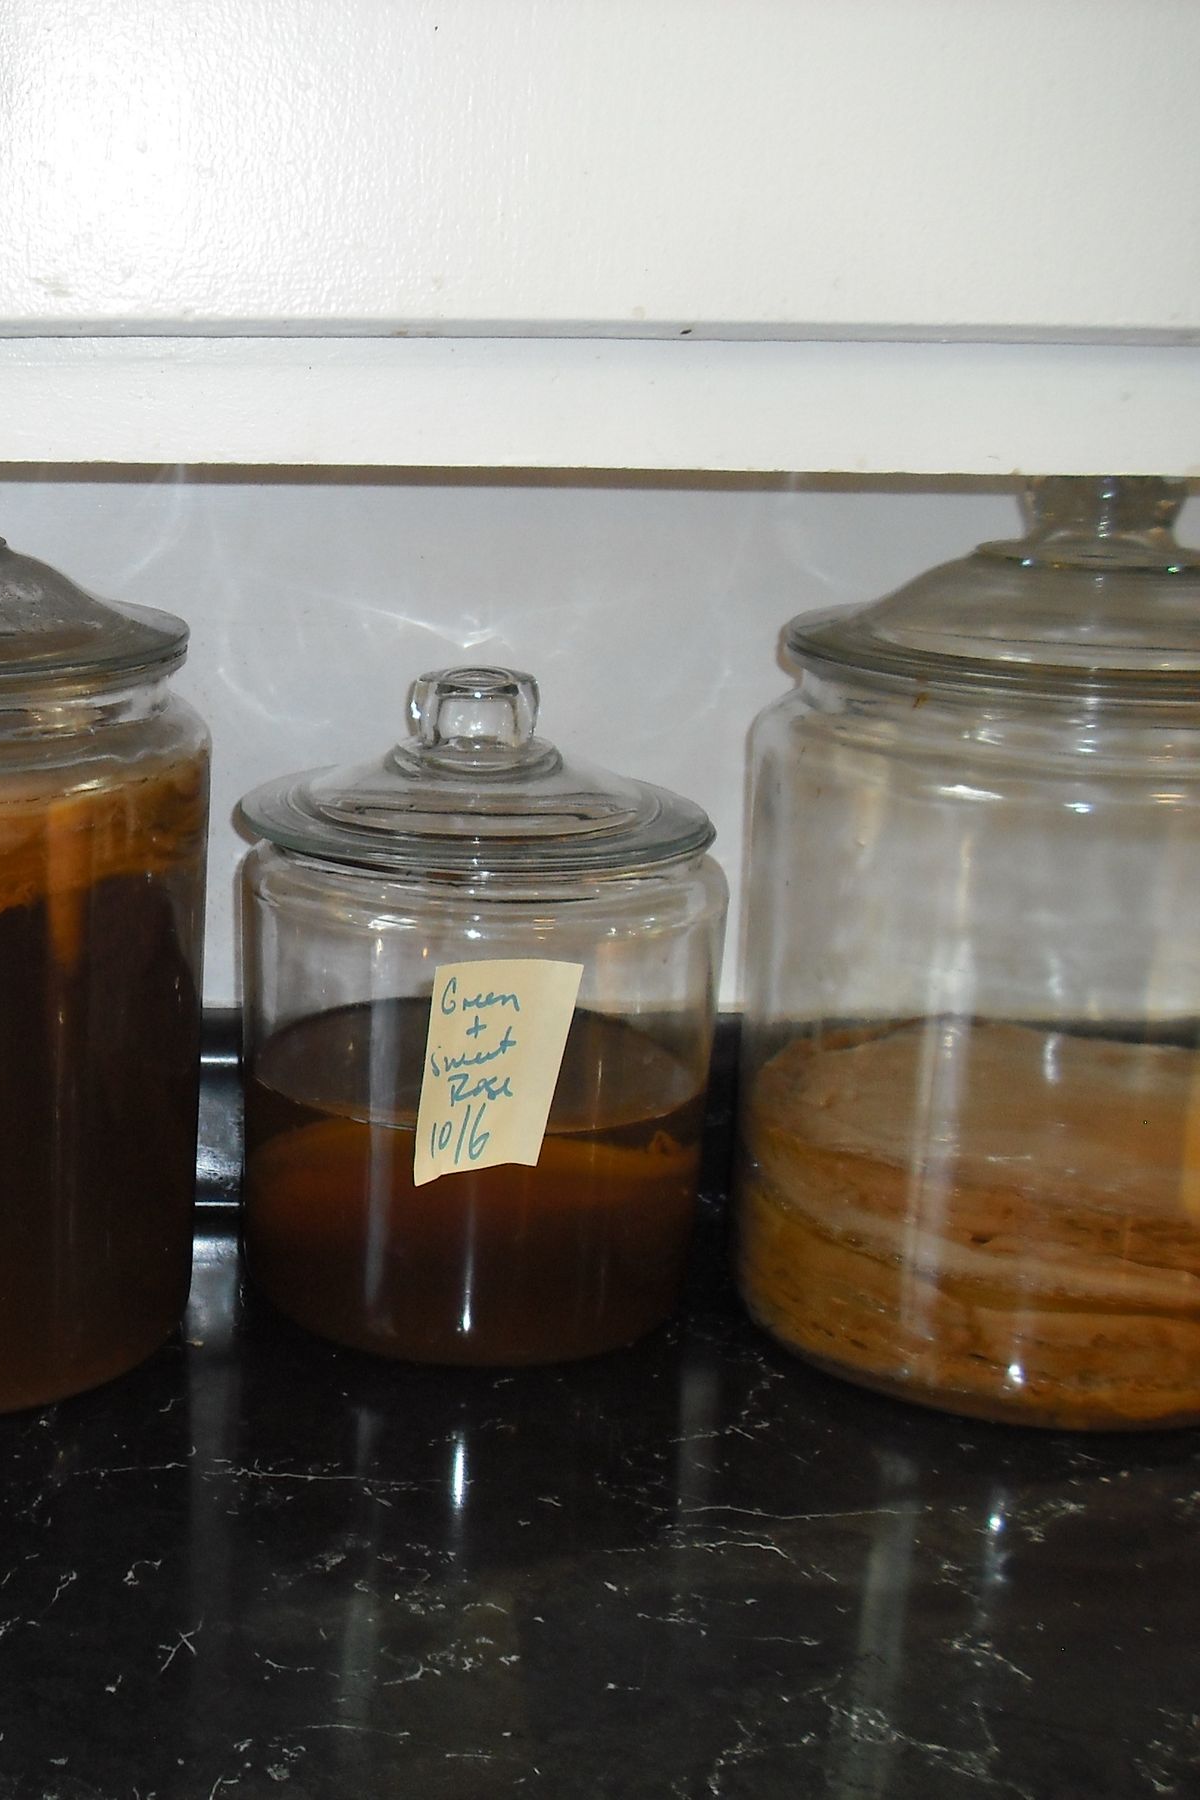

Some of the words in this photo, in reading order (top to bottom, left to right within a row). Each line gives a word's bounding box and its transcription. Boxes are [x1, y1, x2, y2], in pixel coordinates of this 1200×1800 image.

[441, 976, 520, 1016] Green
[447, 1072, 514, 1107] Rose
[430, 1102, 490, 1165] 10/6
